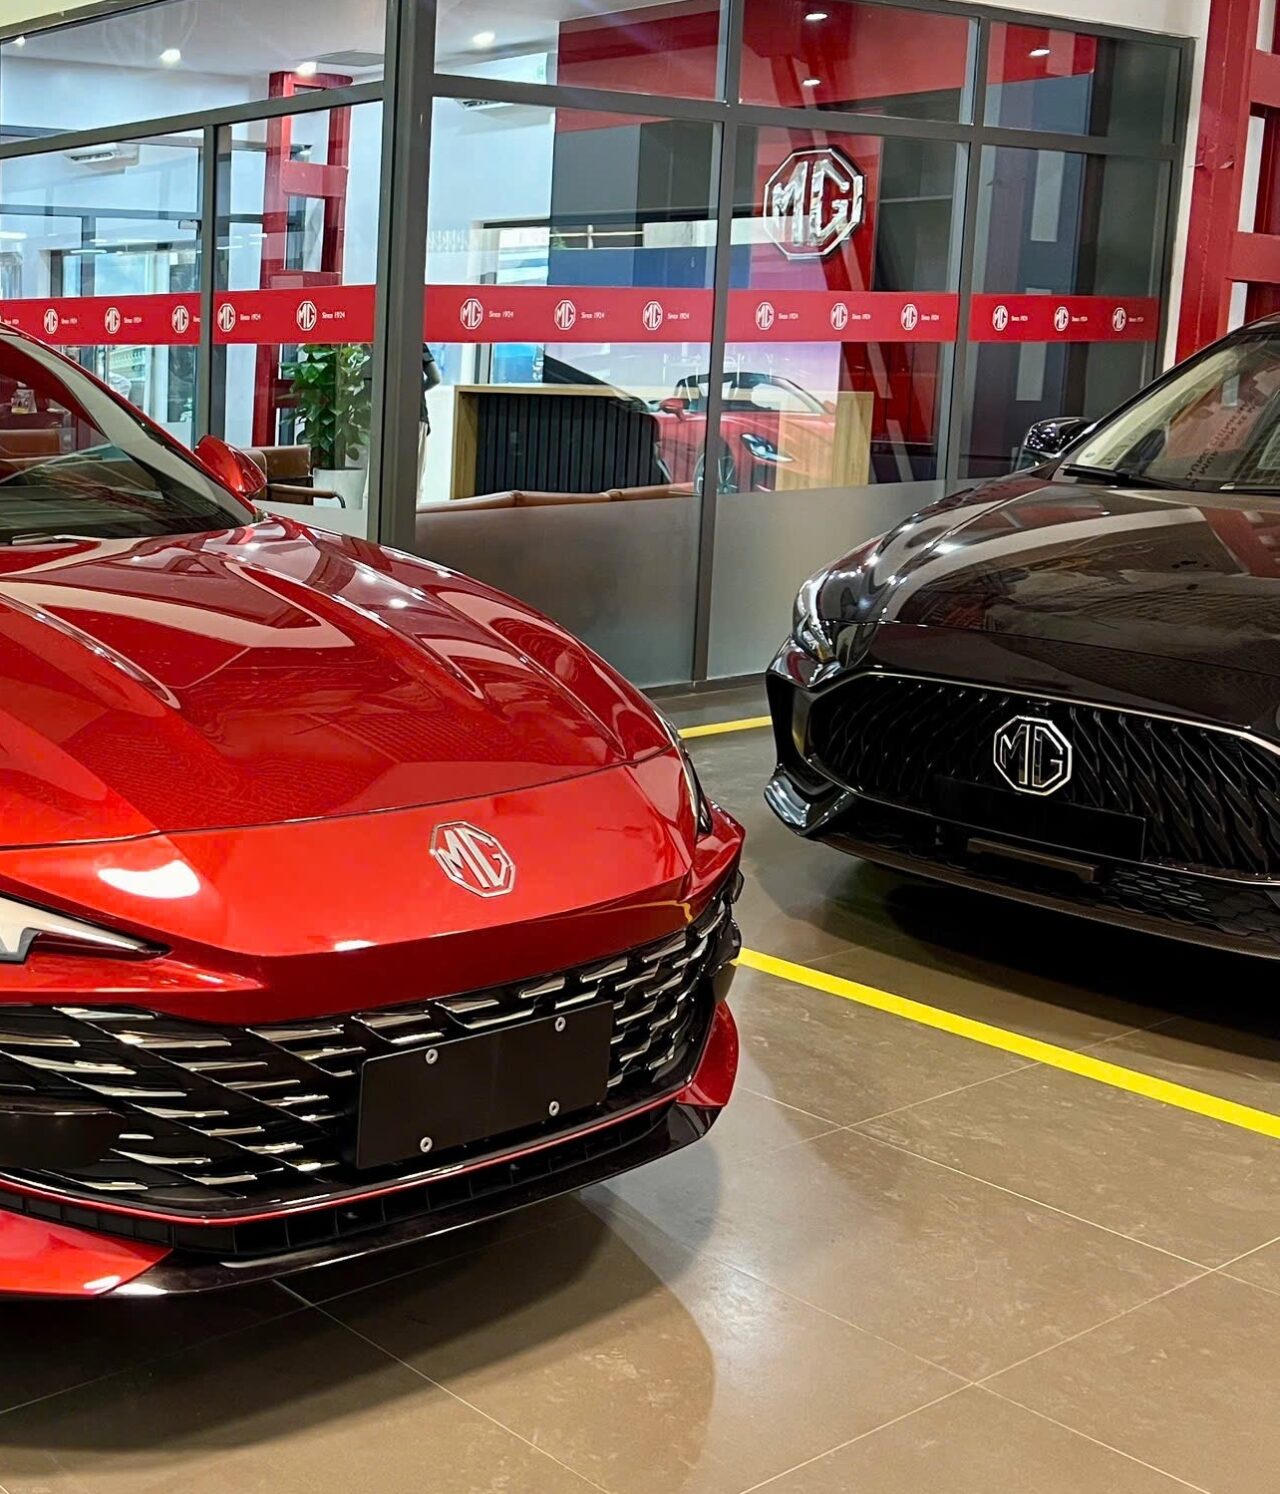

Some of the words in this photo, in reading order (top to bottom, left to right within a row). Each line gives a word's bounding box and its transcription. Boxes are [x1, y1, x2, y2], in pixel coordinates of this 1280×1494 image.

[768, 154, 854, 252] MG
[219, 305, 234, 331] MG
[298, 302, 316, 330] MG
[461, 299, 482, 328] MG
[556, 301, 575, 329] MG
[644, 302, 662, 329] MG
[757, 303, 773, 329] MG
[832, 304, 847, 329] MG
[902, 305, 916, 329] MG
[997, 719, 1067, 791] MG
[433, 825, 511, 893] MG
